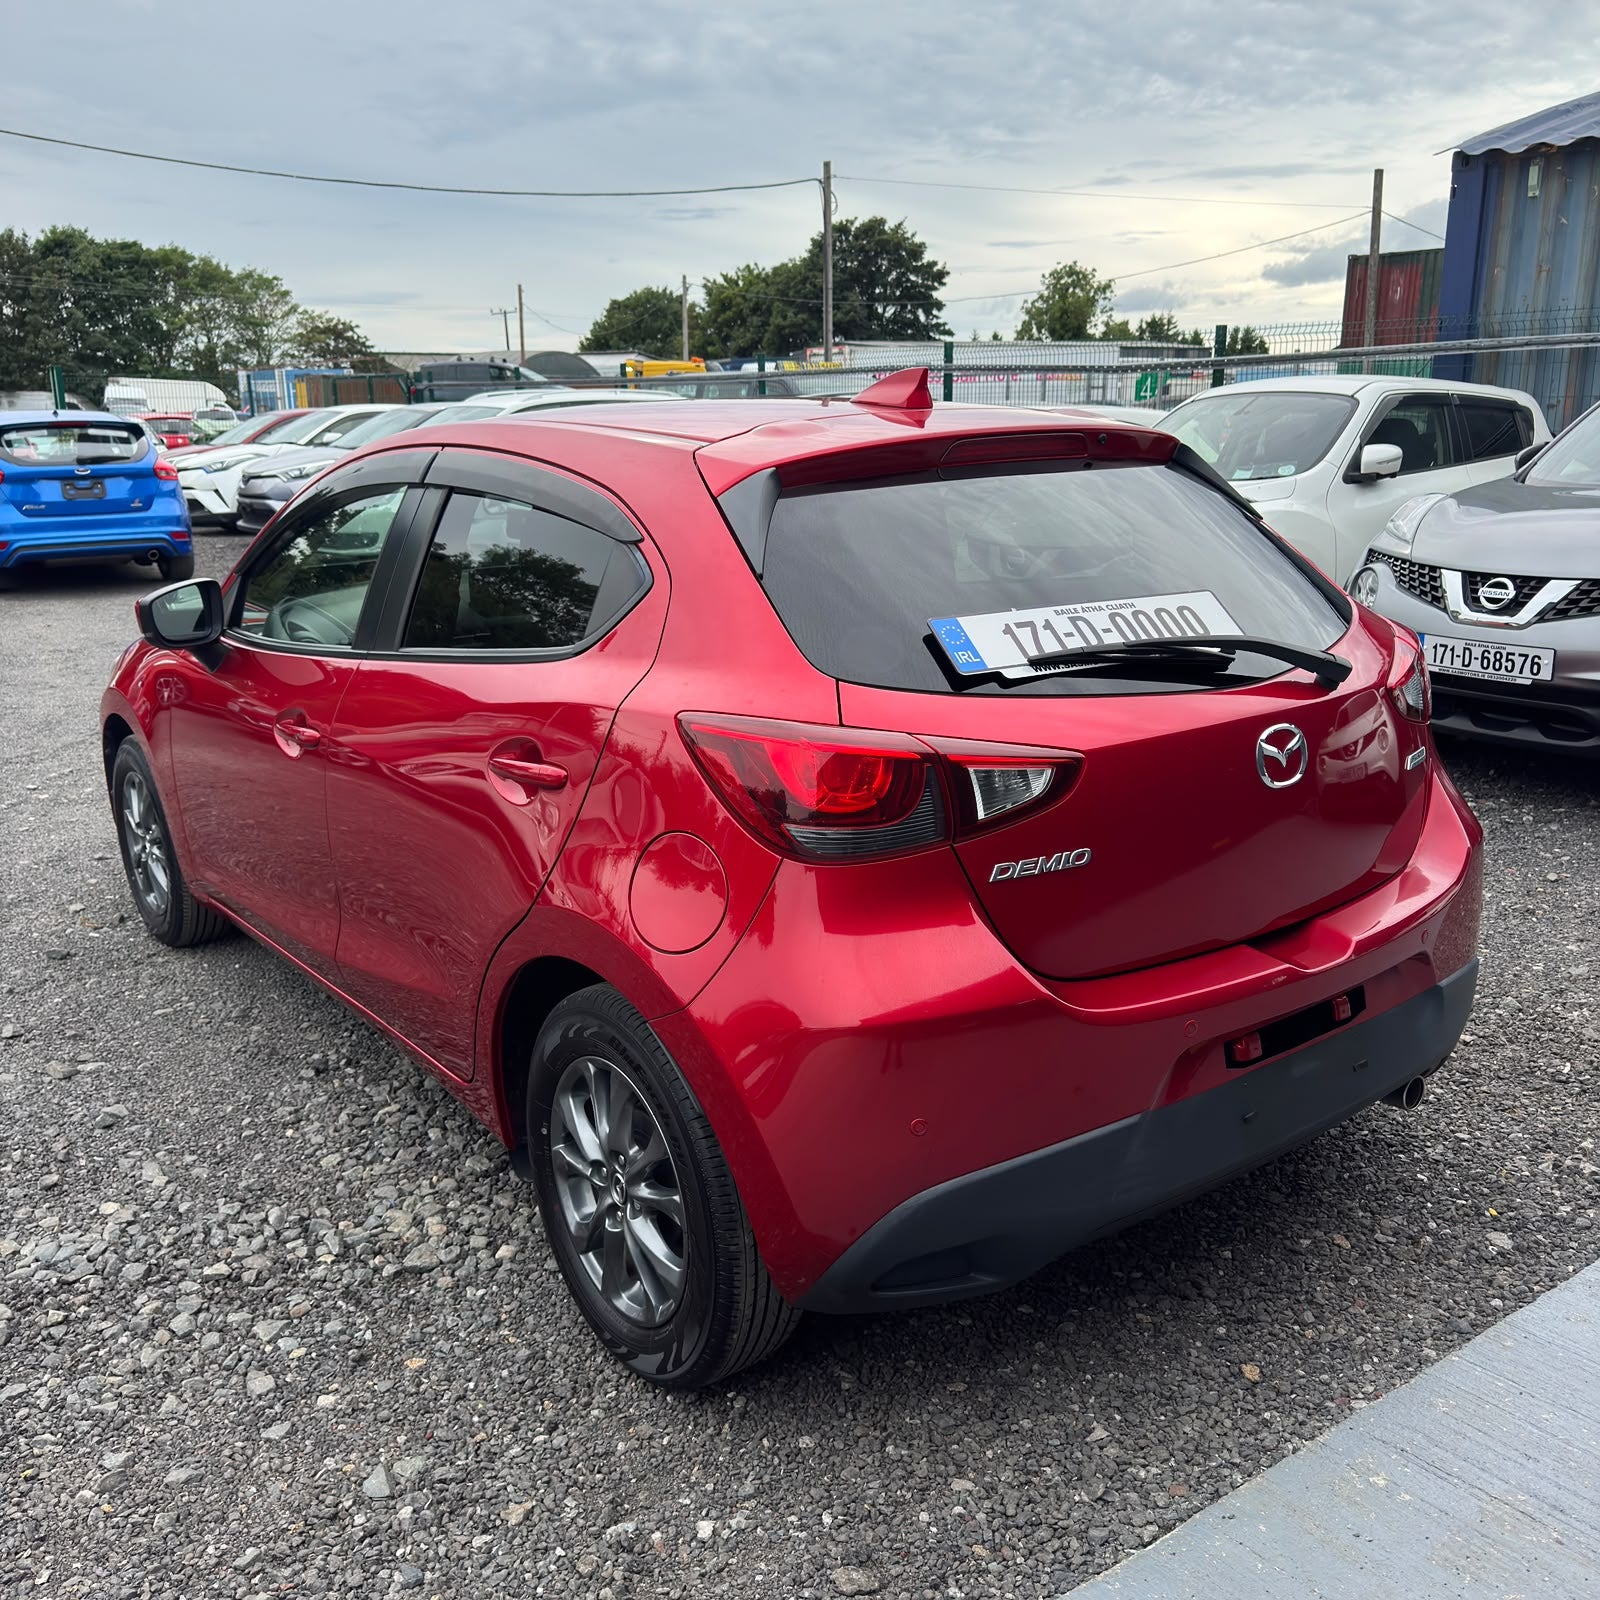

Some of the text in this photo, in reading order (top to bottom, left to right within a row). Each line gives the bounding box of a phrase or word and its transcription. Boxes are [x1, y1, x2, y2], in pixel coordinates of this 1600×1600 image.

[1140, 377, 1153, 400] 4
[1480, 589, 1511, 597] NISSAN
[1053, 608, 1080, 616] BAILE
[1106, 603, 1136, 611] CLIATH
[1002, 606, 1211, 661] 171-D-0000
[954, 651, 981, 664] IRL
[1432, 642, 1542, 677] 171-D-68576
[989, 848, 1092, 882] DEMIO
